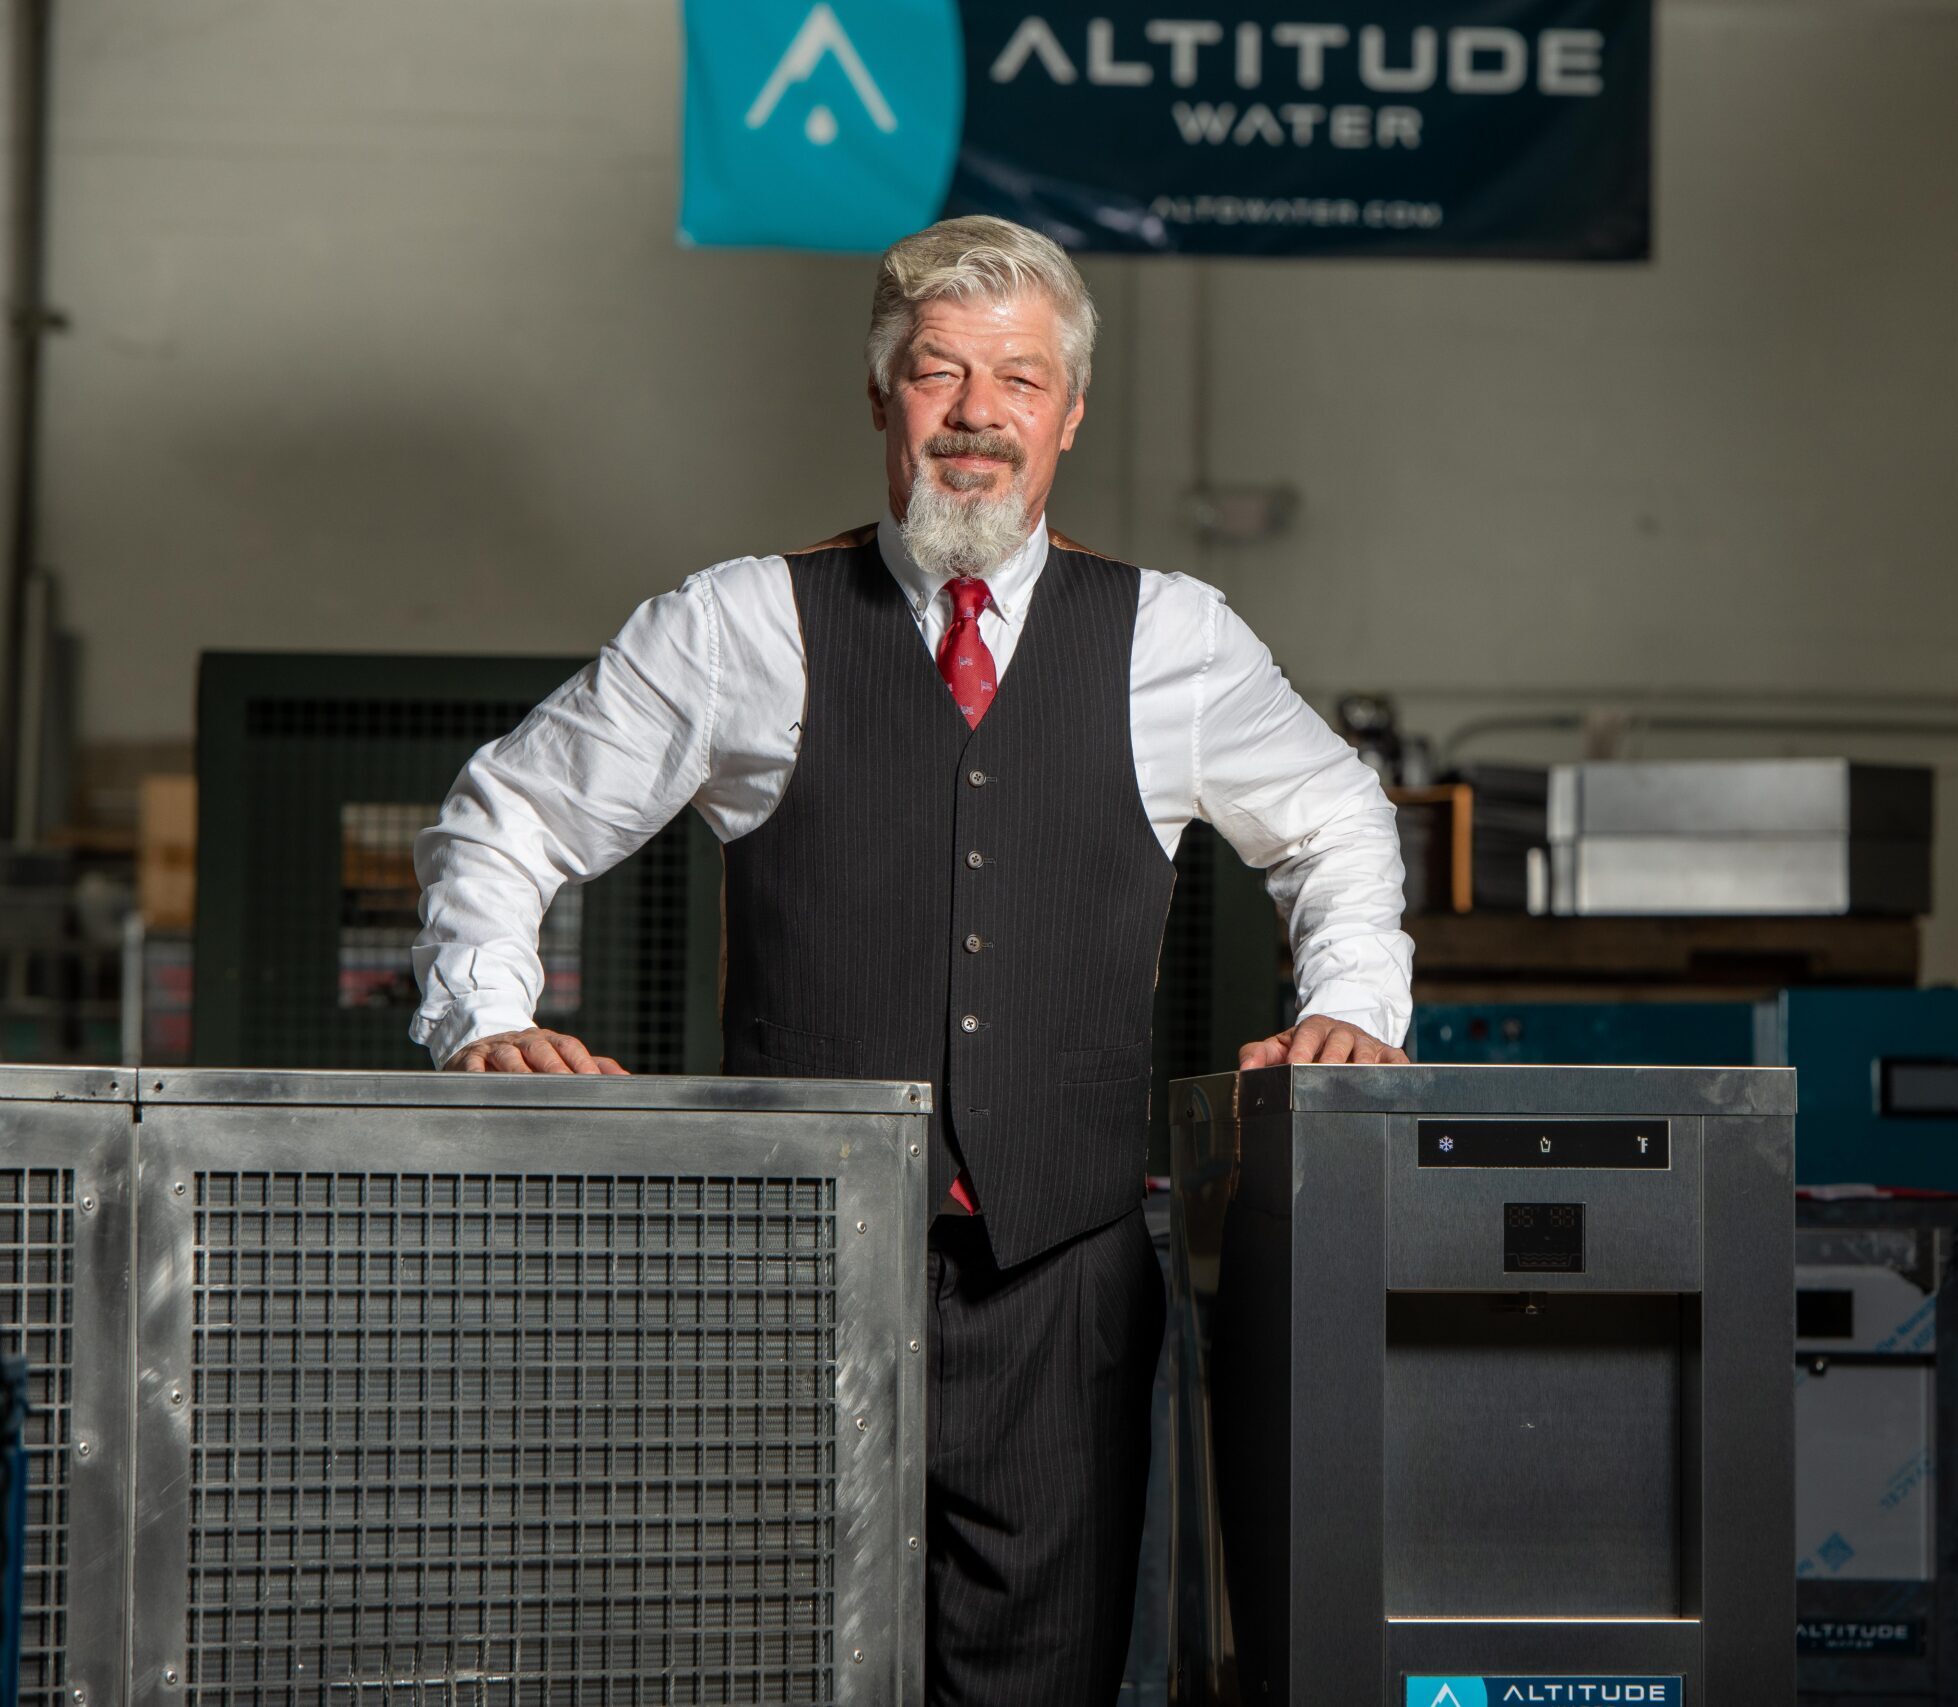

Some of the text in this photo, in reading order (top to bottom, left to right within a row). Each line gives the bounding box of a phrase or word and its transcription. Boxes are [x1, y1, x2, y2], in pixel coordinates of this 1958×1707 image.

[991, 17, 1604, 96] ALTITUDE
[1173, 102, 1424, 149] WATER
[1797, 1624, 1907, 1639] ALTITUDE
[1503, 1685, 1666, 1701] ALTITUDE
